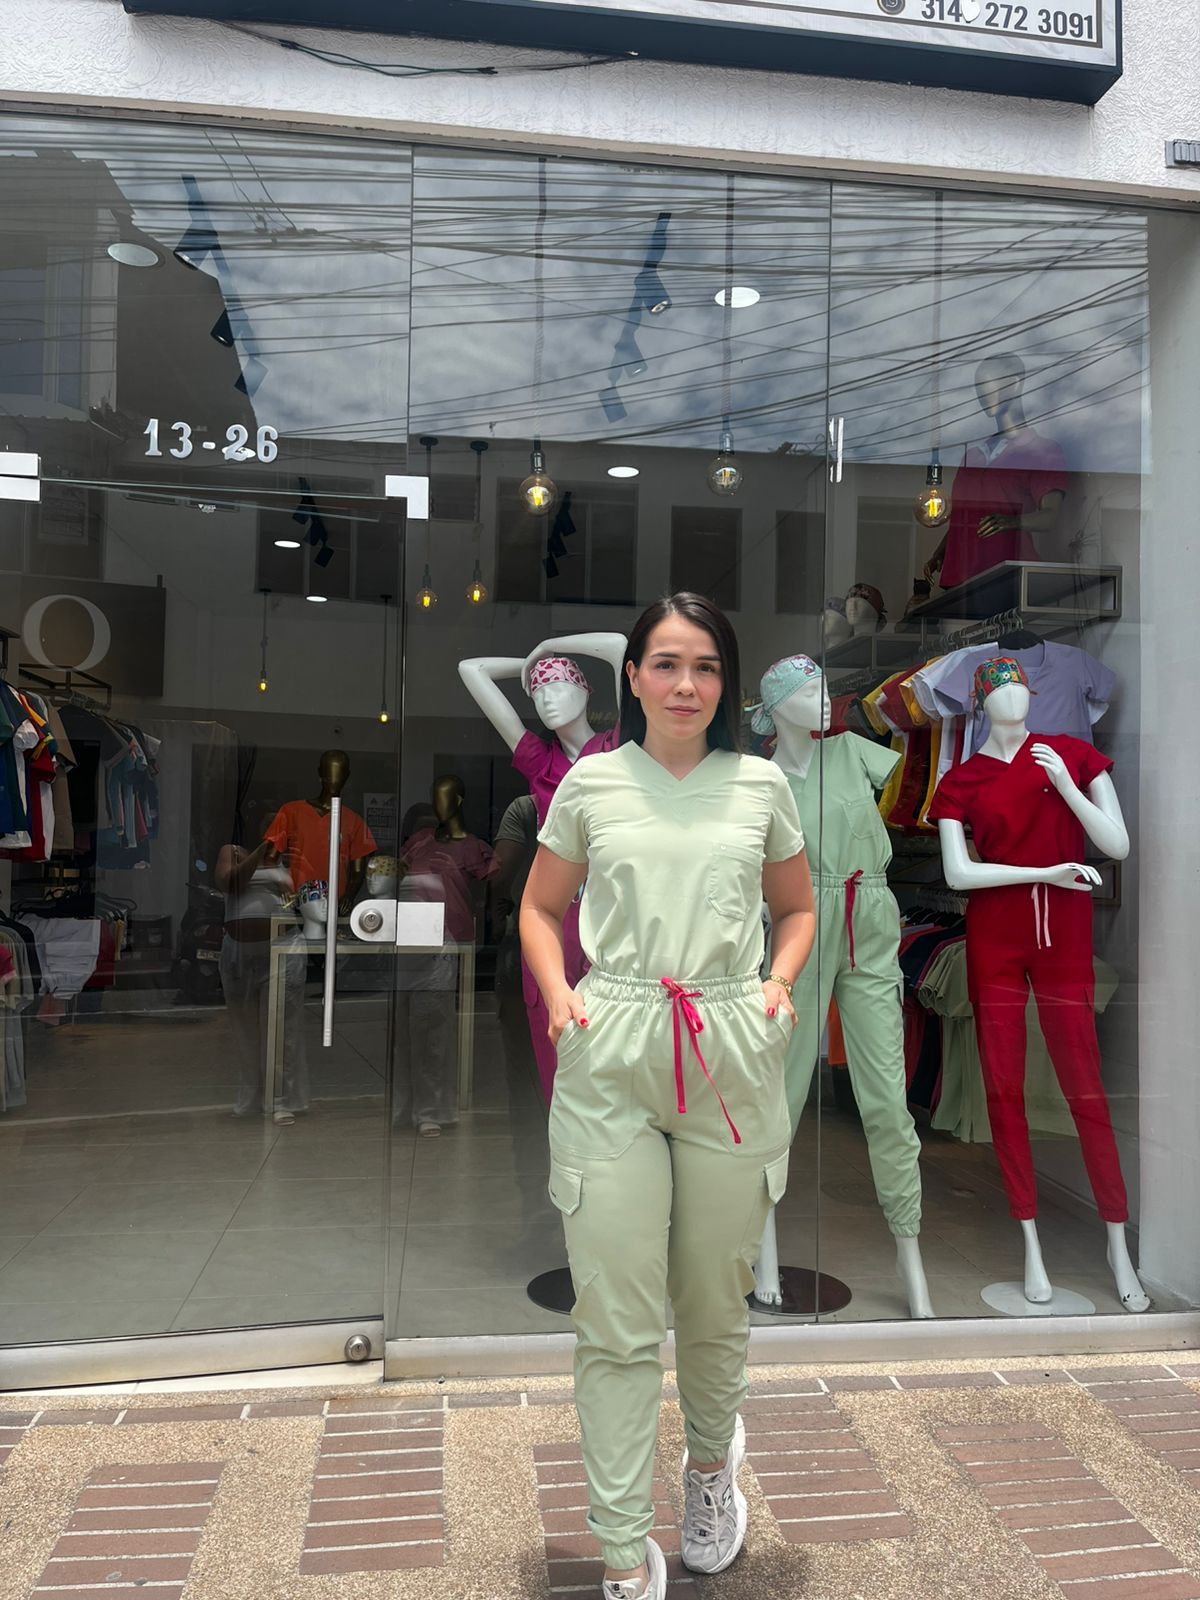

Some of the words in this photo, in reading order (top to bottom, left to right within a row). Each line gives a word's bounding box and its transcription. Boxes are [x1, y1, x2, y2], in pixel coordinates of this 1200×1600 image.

[921, 0, 962, 22] 314
[985, 2, 1028, 31] 272
[1037, 9, 1094, 39] 3091
[143, 418, 279, 463] 13-26
